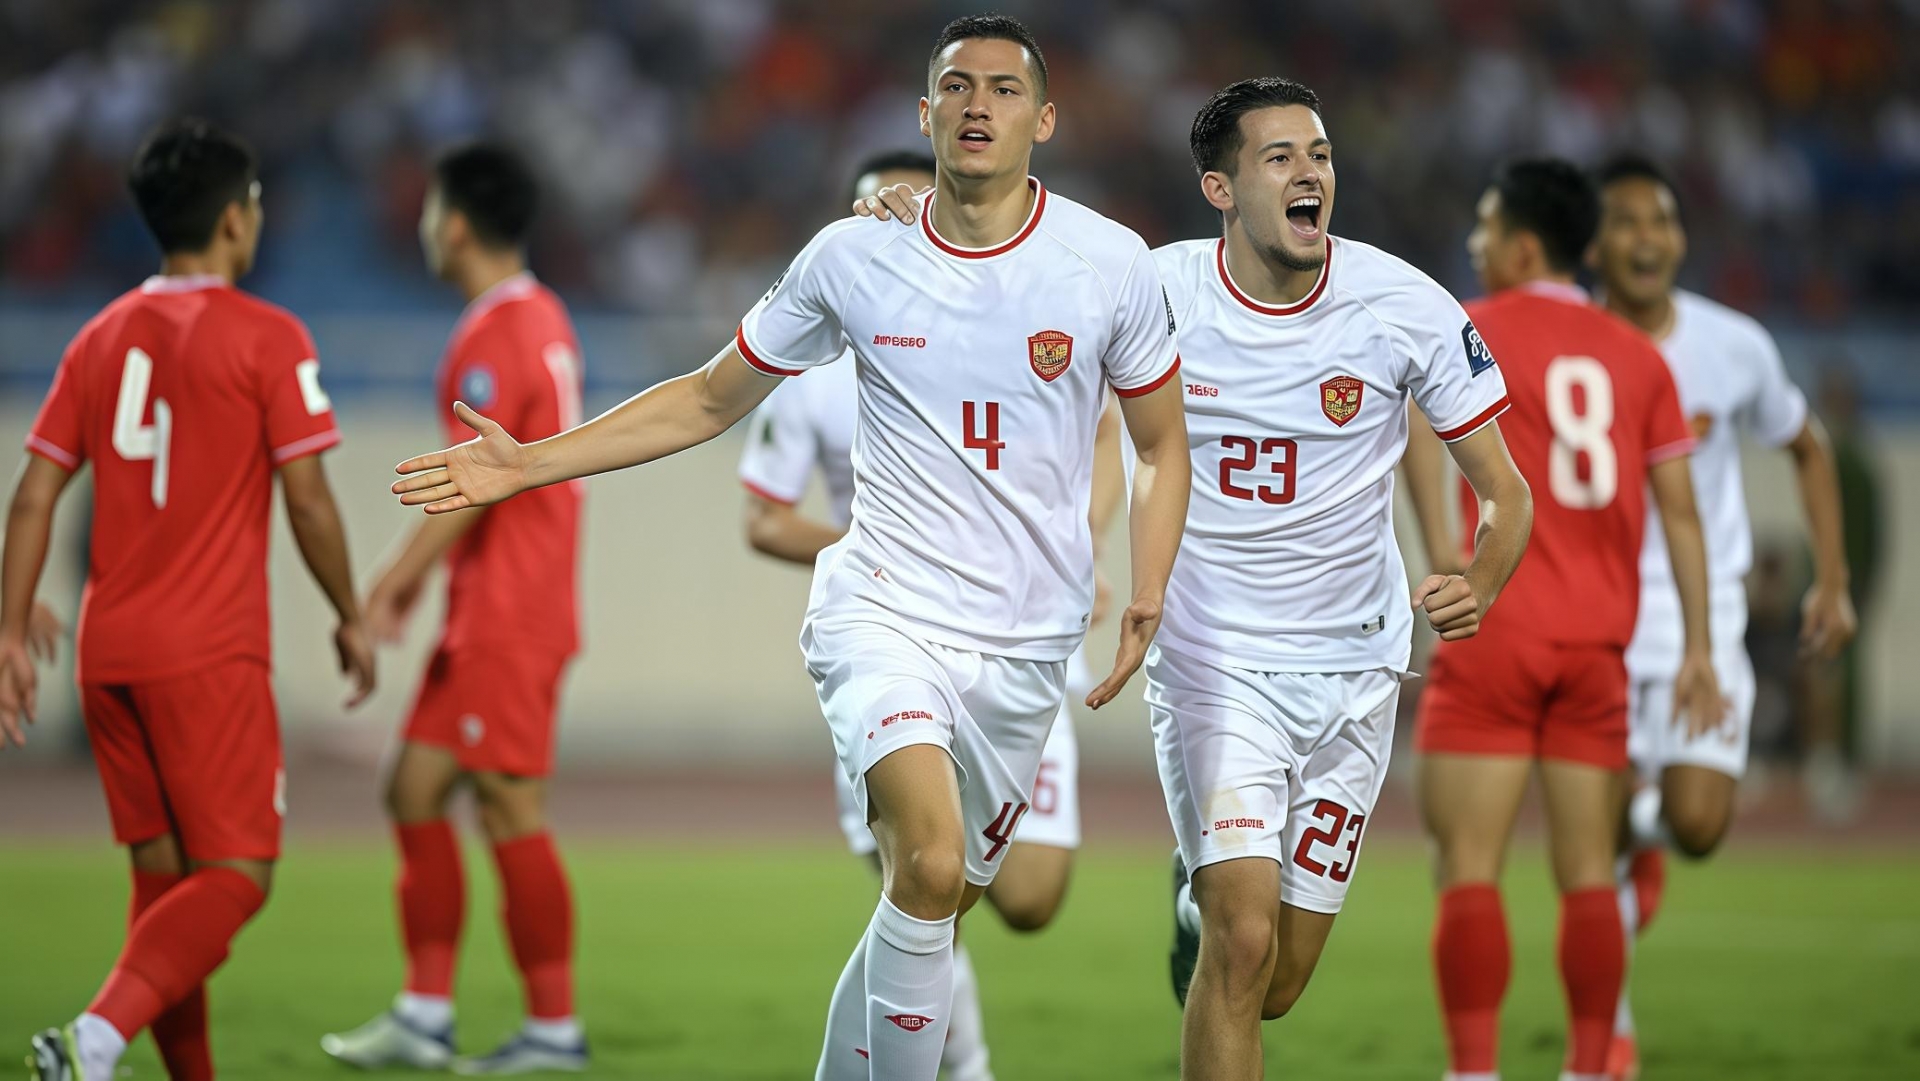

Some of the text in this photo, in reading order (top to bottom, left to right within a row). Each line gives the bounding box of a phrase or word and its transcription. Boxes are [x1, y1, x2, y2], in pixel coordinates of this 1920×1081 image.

[112, 346, 172, 509] 4
[962, 400, 1006, 470] 4
[1545, 354, 1618, 510] 8
[1219, 434, 1298, 504] 23
[982, 801, 1030, 862] 4
[1293, 798, 1365, 883] 23
